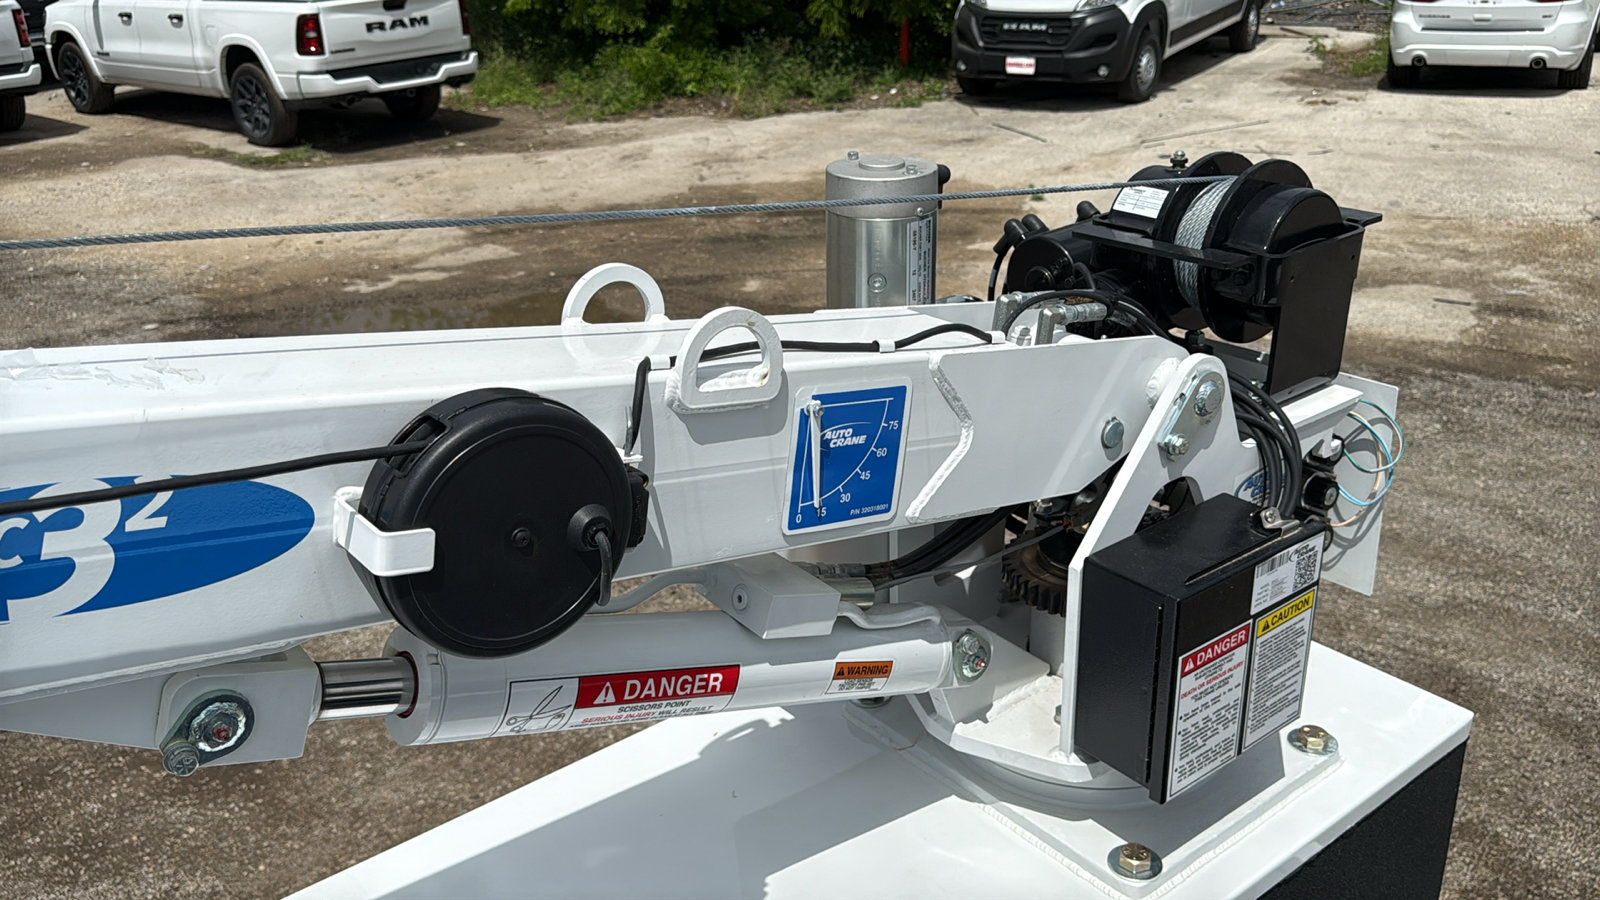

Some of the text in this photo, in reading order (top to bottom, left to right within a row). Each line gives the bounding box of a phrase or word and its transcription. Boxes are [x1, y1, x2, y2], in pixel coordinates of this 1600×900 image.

[366, 16, 428, 32] RAM
[888, 420, 899, 430] 75
[824, 428, 853, 440] AUTO
[830, 435, 866, 448] CRANE
[876, 448, 887, 457] 60
[860, 470, 870, 480] 45
[840, 493, 850, 503] 30
[817, 506, 827, 517] 15
[796, 514, 802, 523] 0
[1270, 595, 1310, 627] CAUTION
[1196, 628, 1246, 666] DANGER
[847, 664, 888, 676] WARNING
[624, 672, 723, 700] DANGER
[1180, 660, 1243, 700] DEATH OR SERIOUS INJURY
[618, 700, 692, 713] SCISSORS POINT
[582, 714, 623, 724] SERIOUS
[624, 711, 657, 719] INJURY
[680, 705, 714, 714] RESULT
